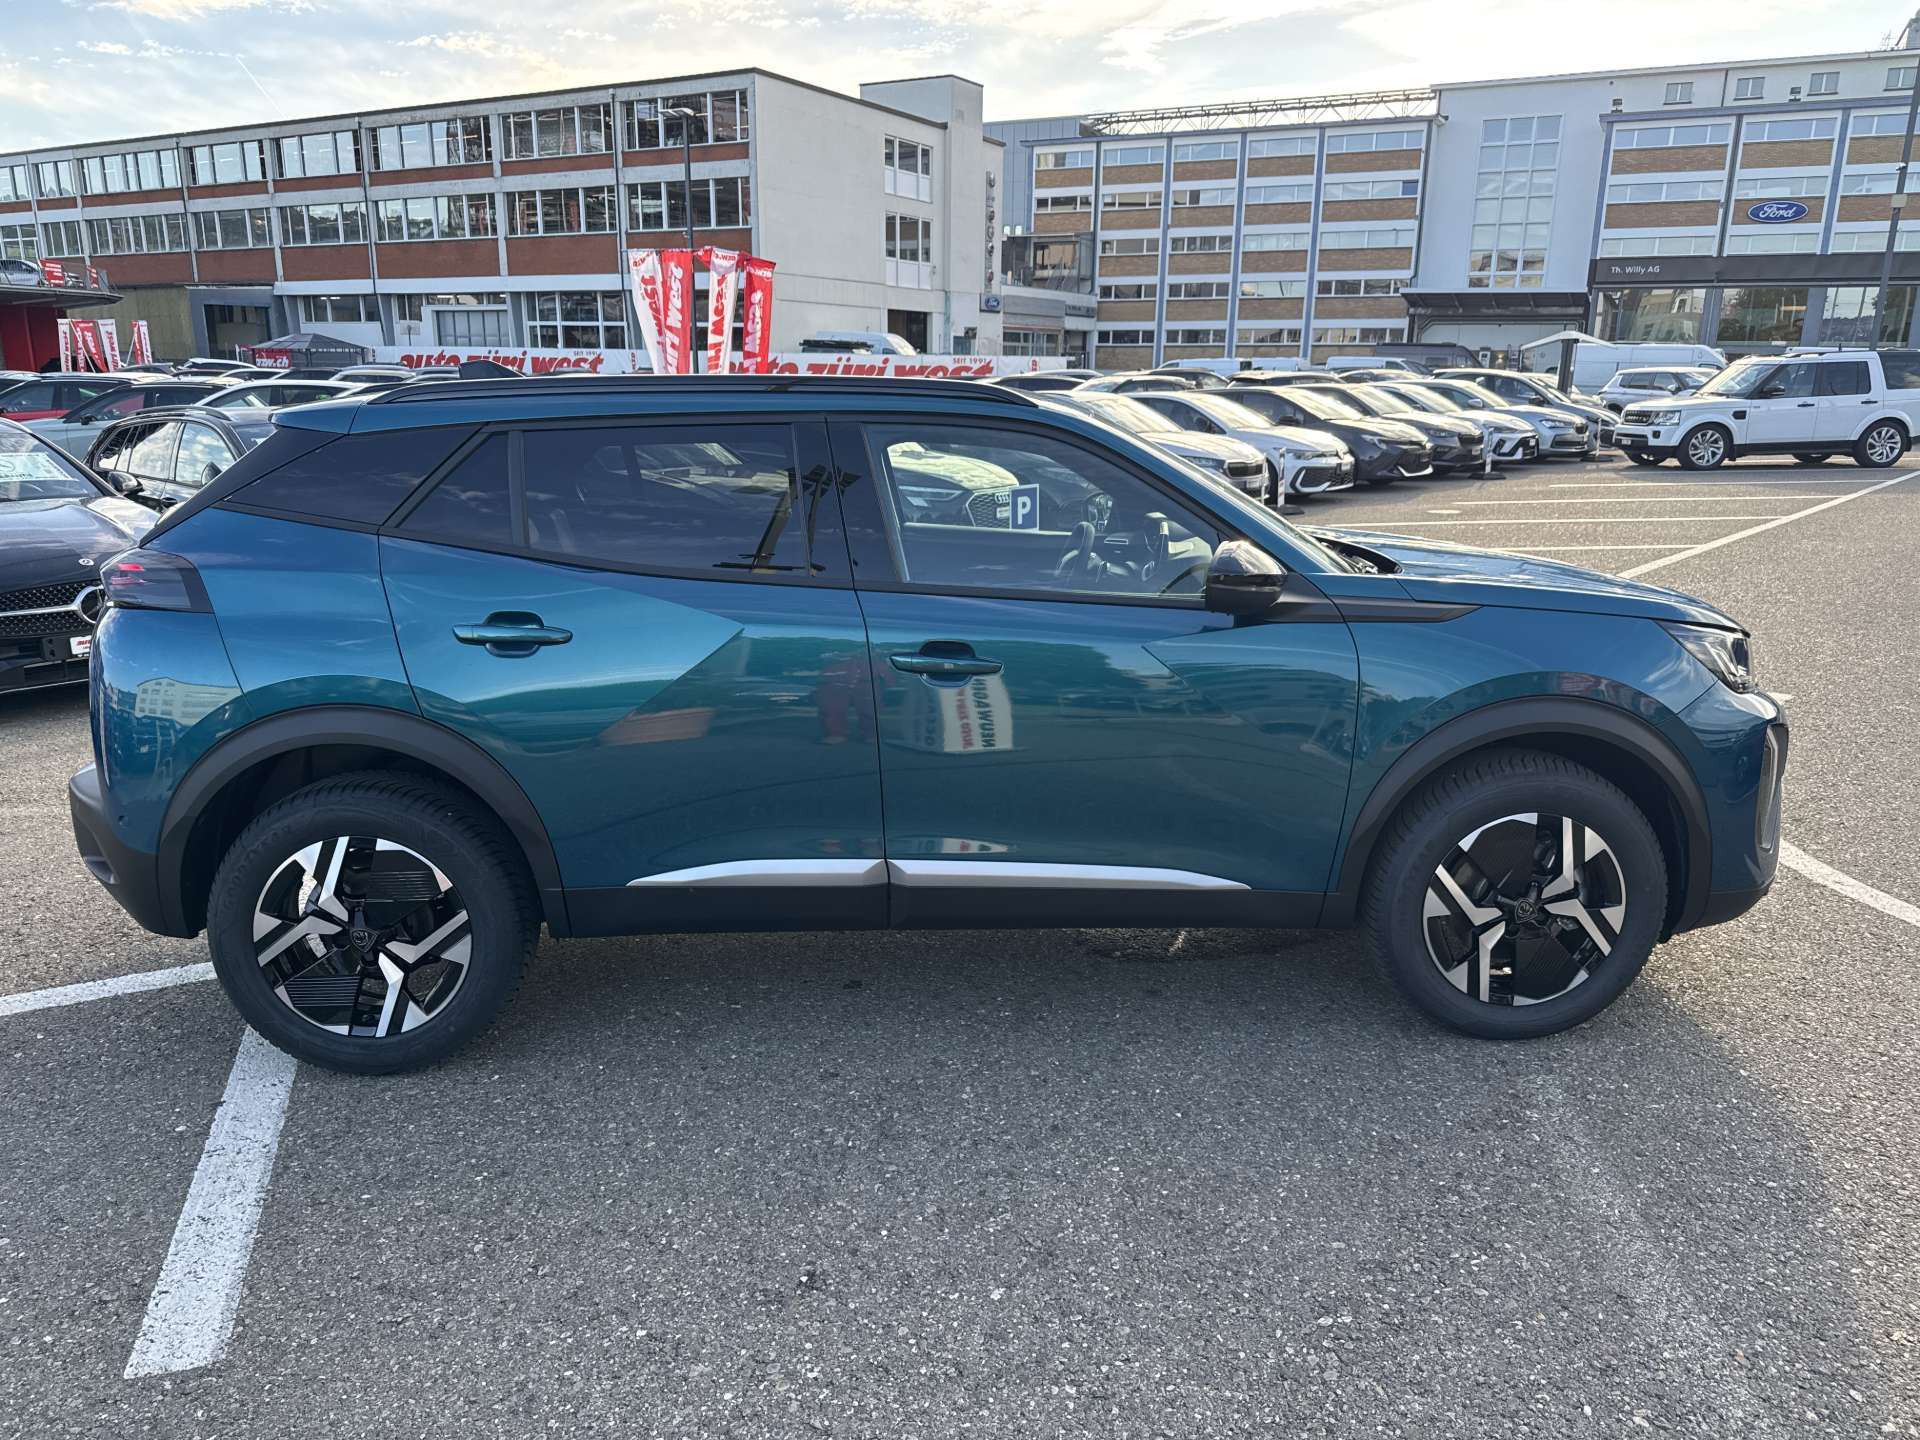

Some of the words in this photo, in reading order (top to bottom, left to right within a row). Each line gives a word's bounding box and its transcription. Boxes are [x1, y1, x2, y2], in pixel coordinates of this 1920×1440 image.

[1759, 204, 1797, 218] Ford
[1625, 265, 1646, 276] Willy
[1647, 265, 1660, 273] AG
[1017, 496, 1031, 525] P
